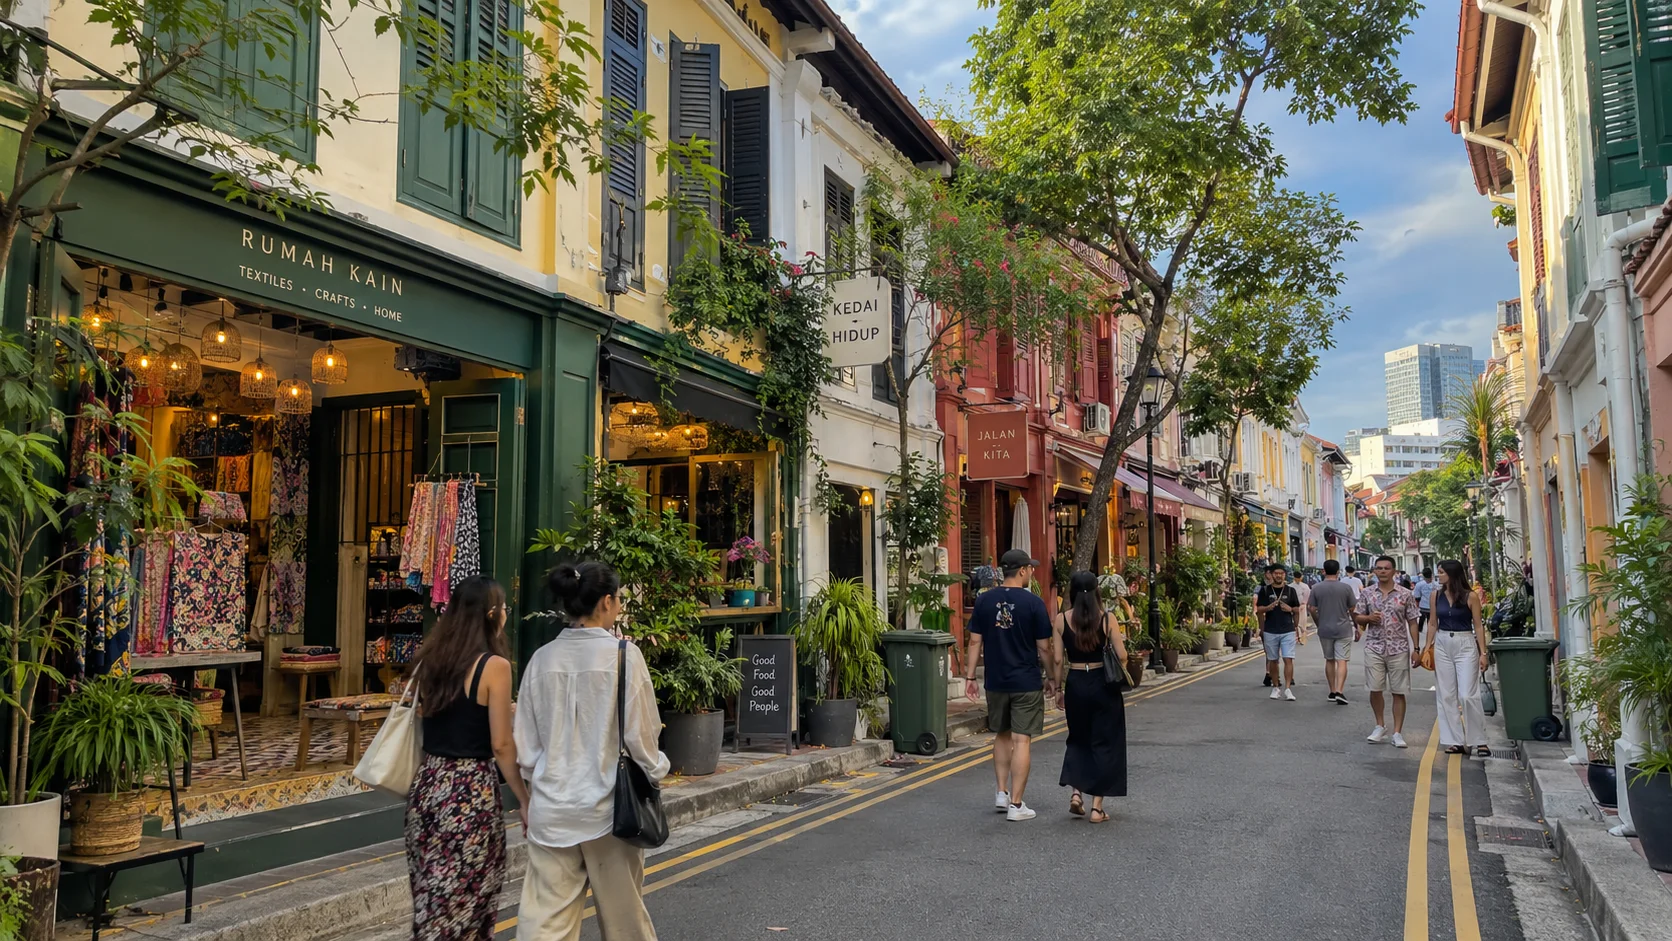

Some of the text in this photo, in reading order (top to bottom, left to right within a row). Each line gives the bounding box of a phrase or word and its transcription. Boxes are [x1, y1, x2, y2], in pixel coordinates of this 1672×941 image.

[242, 228, 402, 296] RUMAH KAIN
[239, 265, 402, 322] TEXTILES CRAFTS HOME
[833, 299, 877, 315] KEDAI
[832, 327, 879, 343] HIDUP
[977, 429, 1015, 441] JALAN
[983, 450, 1010, 460] KITA
[752, 653, 775, 665] Good
[753, 668, 775, 680] Food
[751, 685, 775, 697] Good
[749, 699, 780, 715] People
